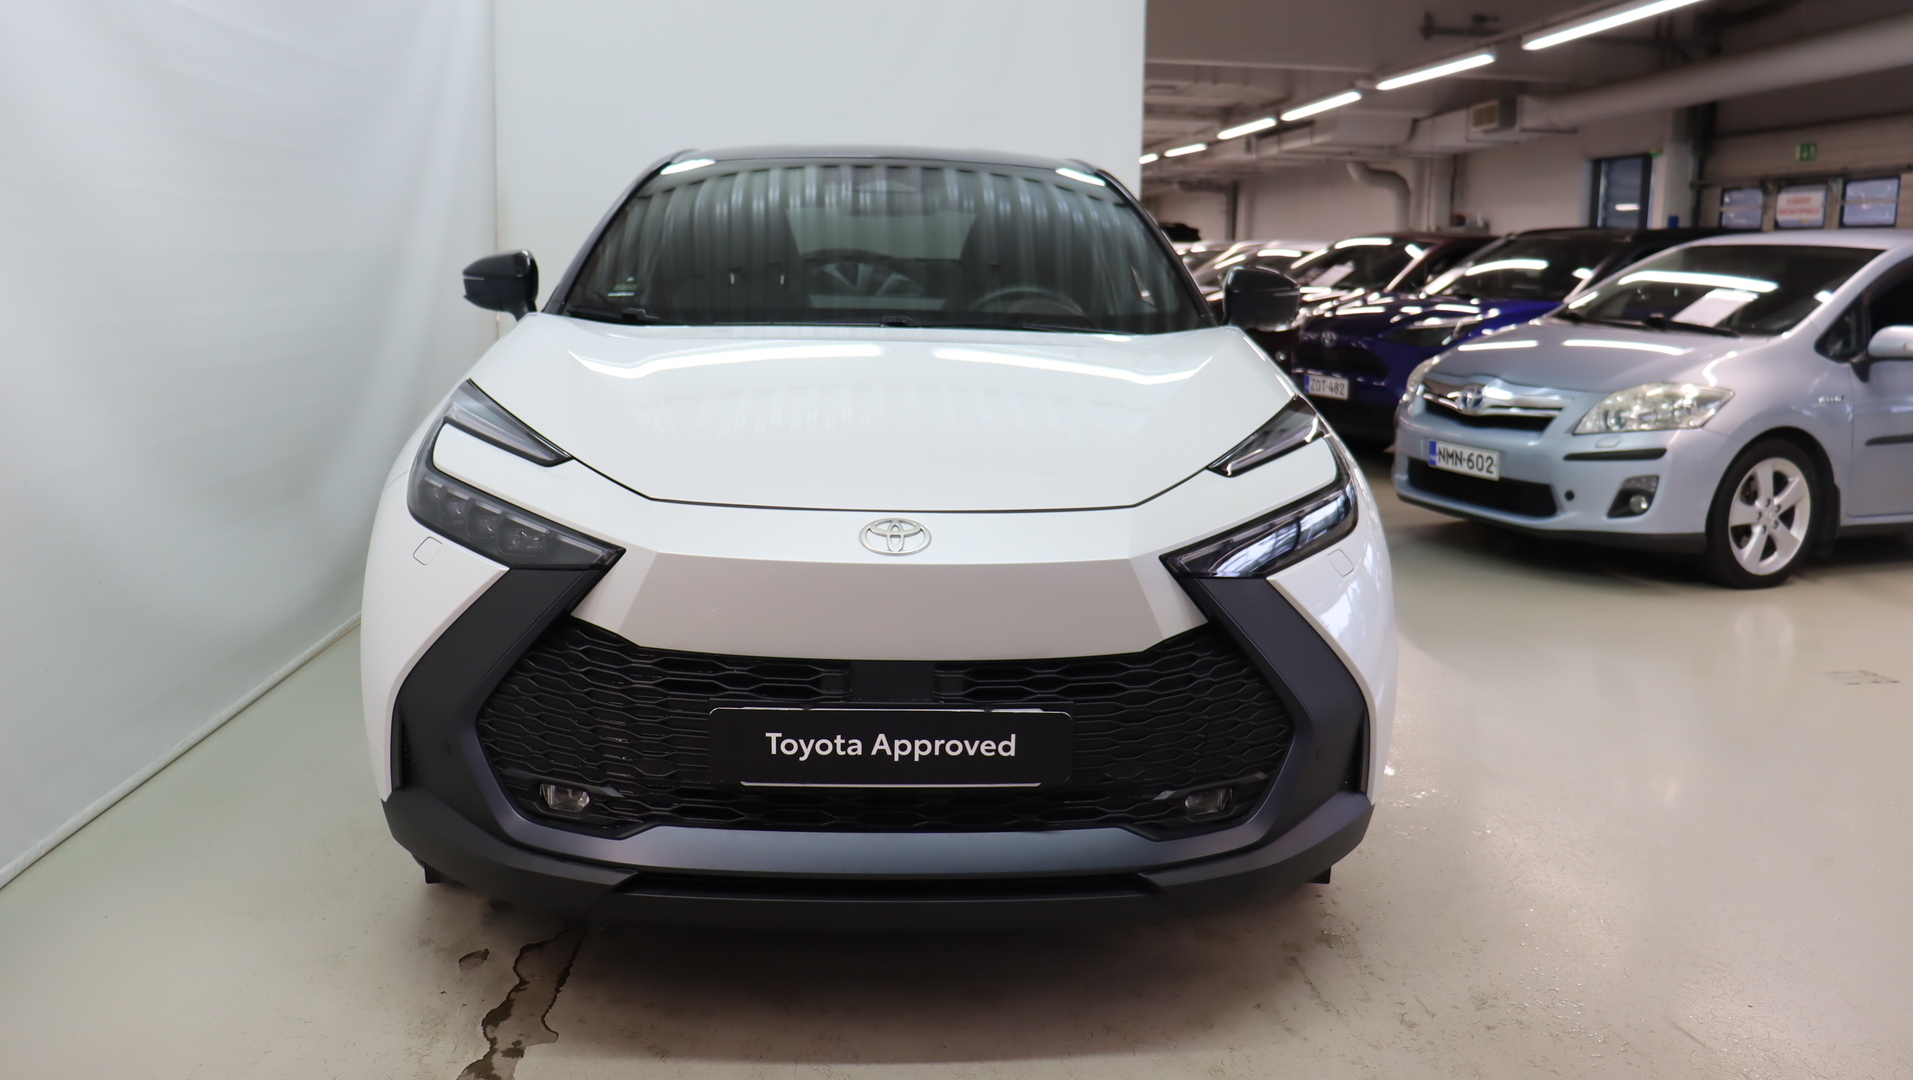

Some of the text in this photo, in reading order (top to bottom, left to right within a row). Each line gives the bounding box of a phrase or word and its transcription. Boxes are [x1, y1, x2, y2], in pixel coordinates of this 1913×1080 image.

[1437, 446, 1494, 474] NMN-602
[765, 732, 1016, 761] Toyota Approved
